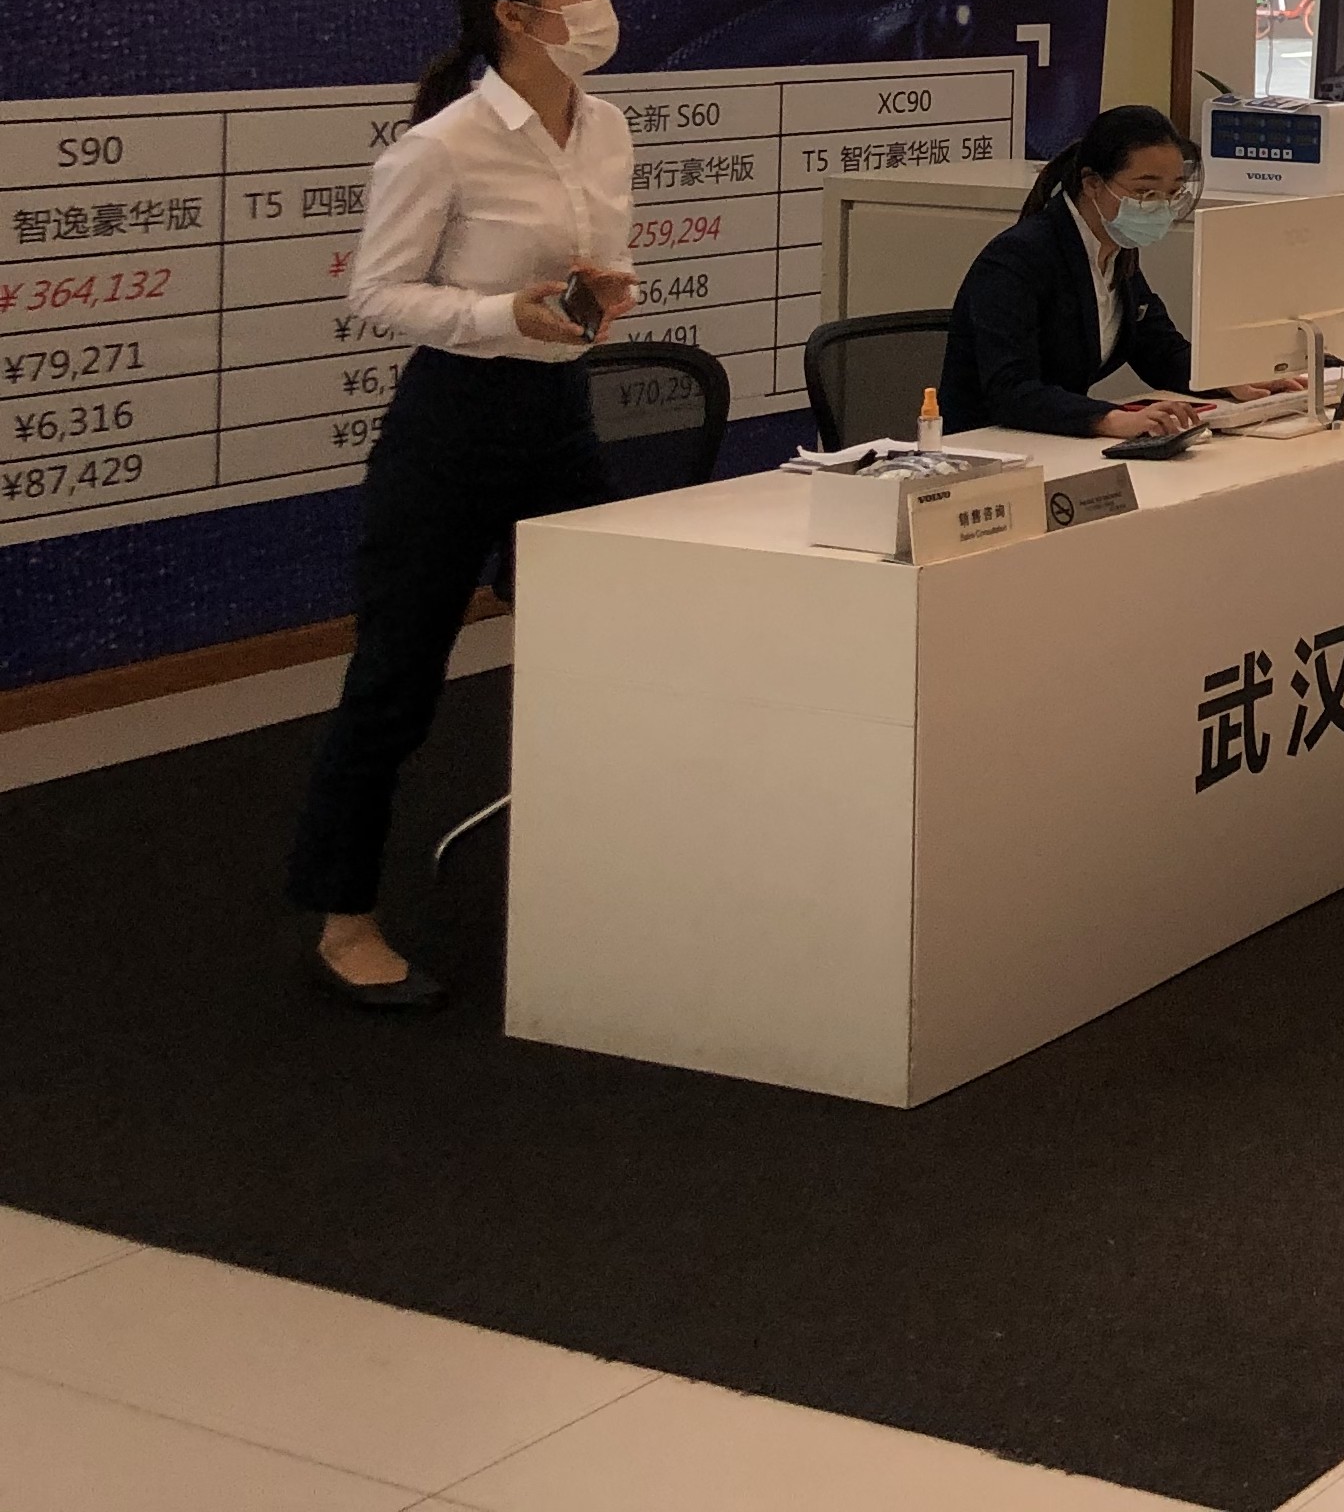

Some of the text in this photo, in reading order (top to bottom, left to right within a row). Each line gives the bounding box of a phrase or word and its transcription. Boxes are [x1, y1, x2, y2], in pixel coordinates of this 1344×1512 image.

[677, 103, 720, 128] S60
[878, 90, 932, 114] XC90
[58, 136, 123, 168] S90
[802, 136, 993, 174] T5 智行豪华版 5座
[1247, 172, 1283, 182] VOLVO
[245, 184, 364, 220] T5 四驱
[13, 197, 203, 245] 智逸豪华版
[4, 341, 144, 384] ¥79,271
[14, 399, 134, 442] ¥6,316
[1, 453, 143, 502] ¥87,429
[917, 490, 951, 504] VOLVO
